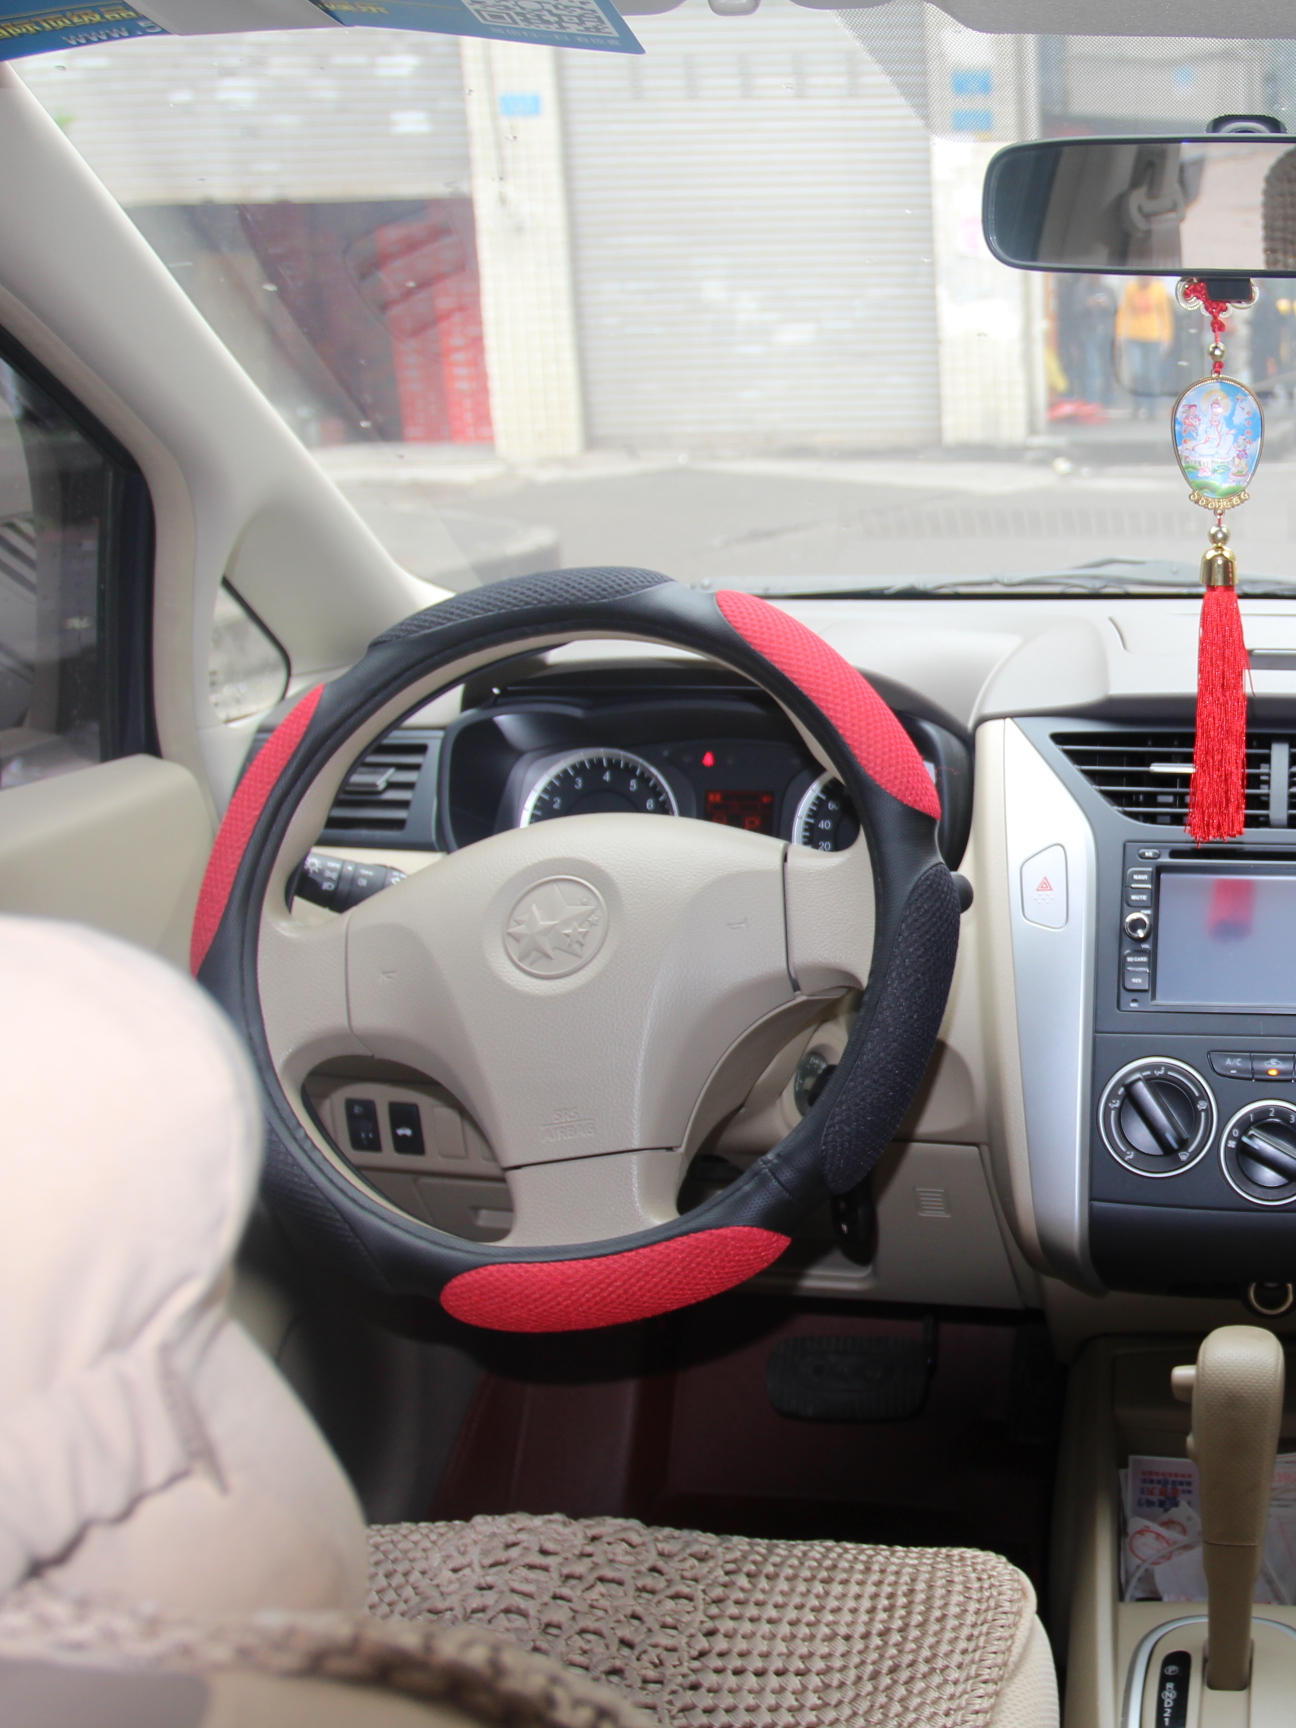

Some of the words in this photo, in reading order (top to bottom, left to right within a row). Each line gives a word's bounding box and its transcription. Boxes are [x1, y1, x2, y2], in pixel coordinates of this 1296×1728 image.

[602, 770, 611, 783] 4
[574, 777, 583, 790] 3
[629, 779, 638, 791] 5
[553, 797, 561, 809] 2
[646, 798, 654, 810] 6
[828, 800, 840, 810] 60
[818, 819, 831, 830] 40
[818, 841, 831, 851] 20
[1225, 1058, 1242, 1066] A/C
[554, 1108, 580, 1122] SRS
[1269, 1108, 1275, 1117] 2
[1290, 1115, 1295, 1124] 3
[543, 1122, 596, 1143] AIRBAG
[1232, 1129, 1239, 1137] 0
[1163, 1699, 1174, 1708] D
[1163, 1708, 1172, 1717] 2
[1163, 1717, 1171, 1726] 1
